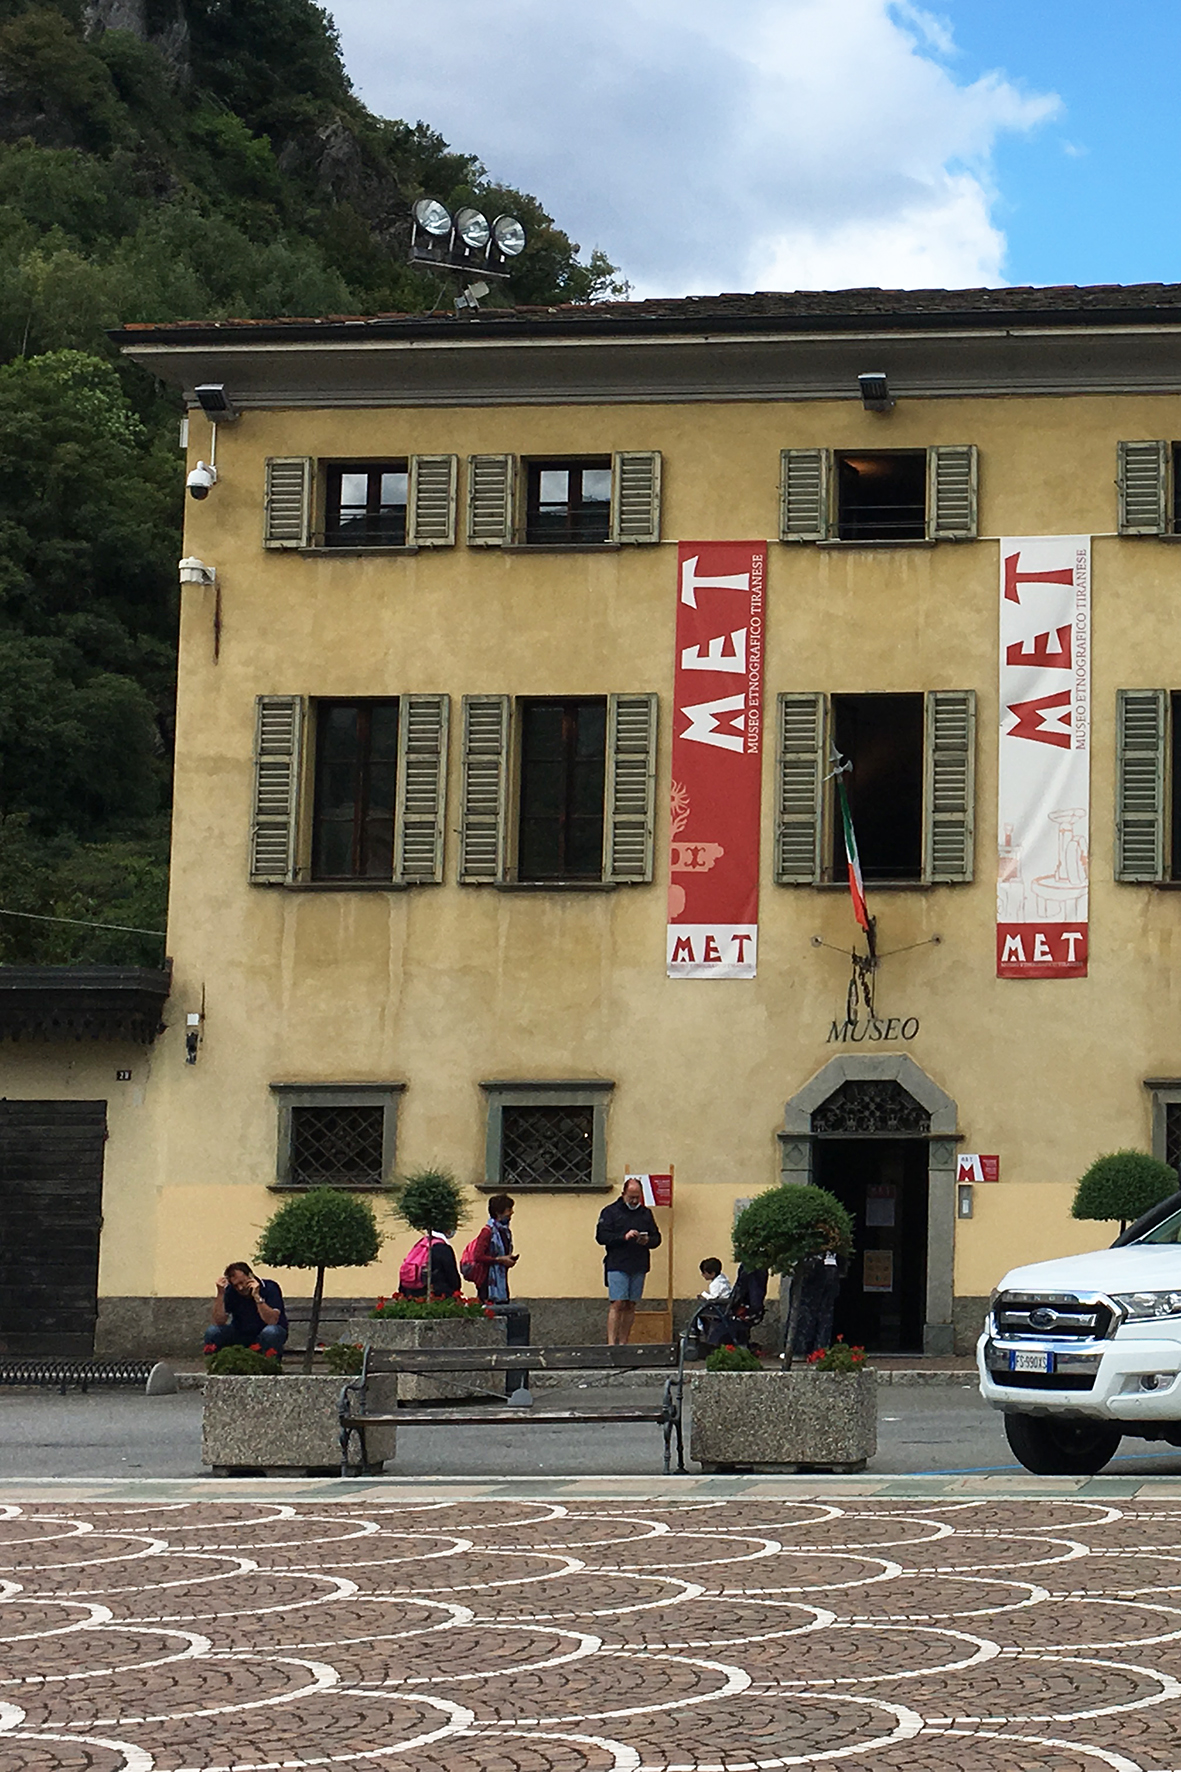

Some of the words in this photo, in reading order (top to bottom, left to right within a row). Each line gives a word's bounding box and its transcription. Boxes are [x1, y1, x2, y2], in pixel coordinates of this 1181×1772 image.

[750, 554, 763, 615] TIRANESE
[1076, 549, 1087, 611] TIRANESE
[679, 555, 750, 754] MET
[748, 616, 762, 706] ETNOGRAFICO
[1004, 551, 1074, 750] MET
[1076, 612, 1087, 702] ETNOGRAFICO
[747, 708, 760, 754] MUSEO
[1076, 705, 1087, 750] MUSEO
[671, 934, 752, 963] MET
[1001, 932, 1083, 961] MET
[826, 1017, 919, 1043] MUSEO
